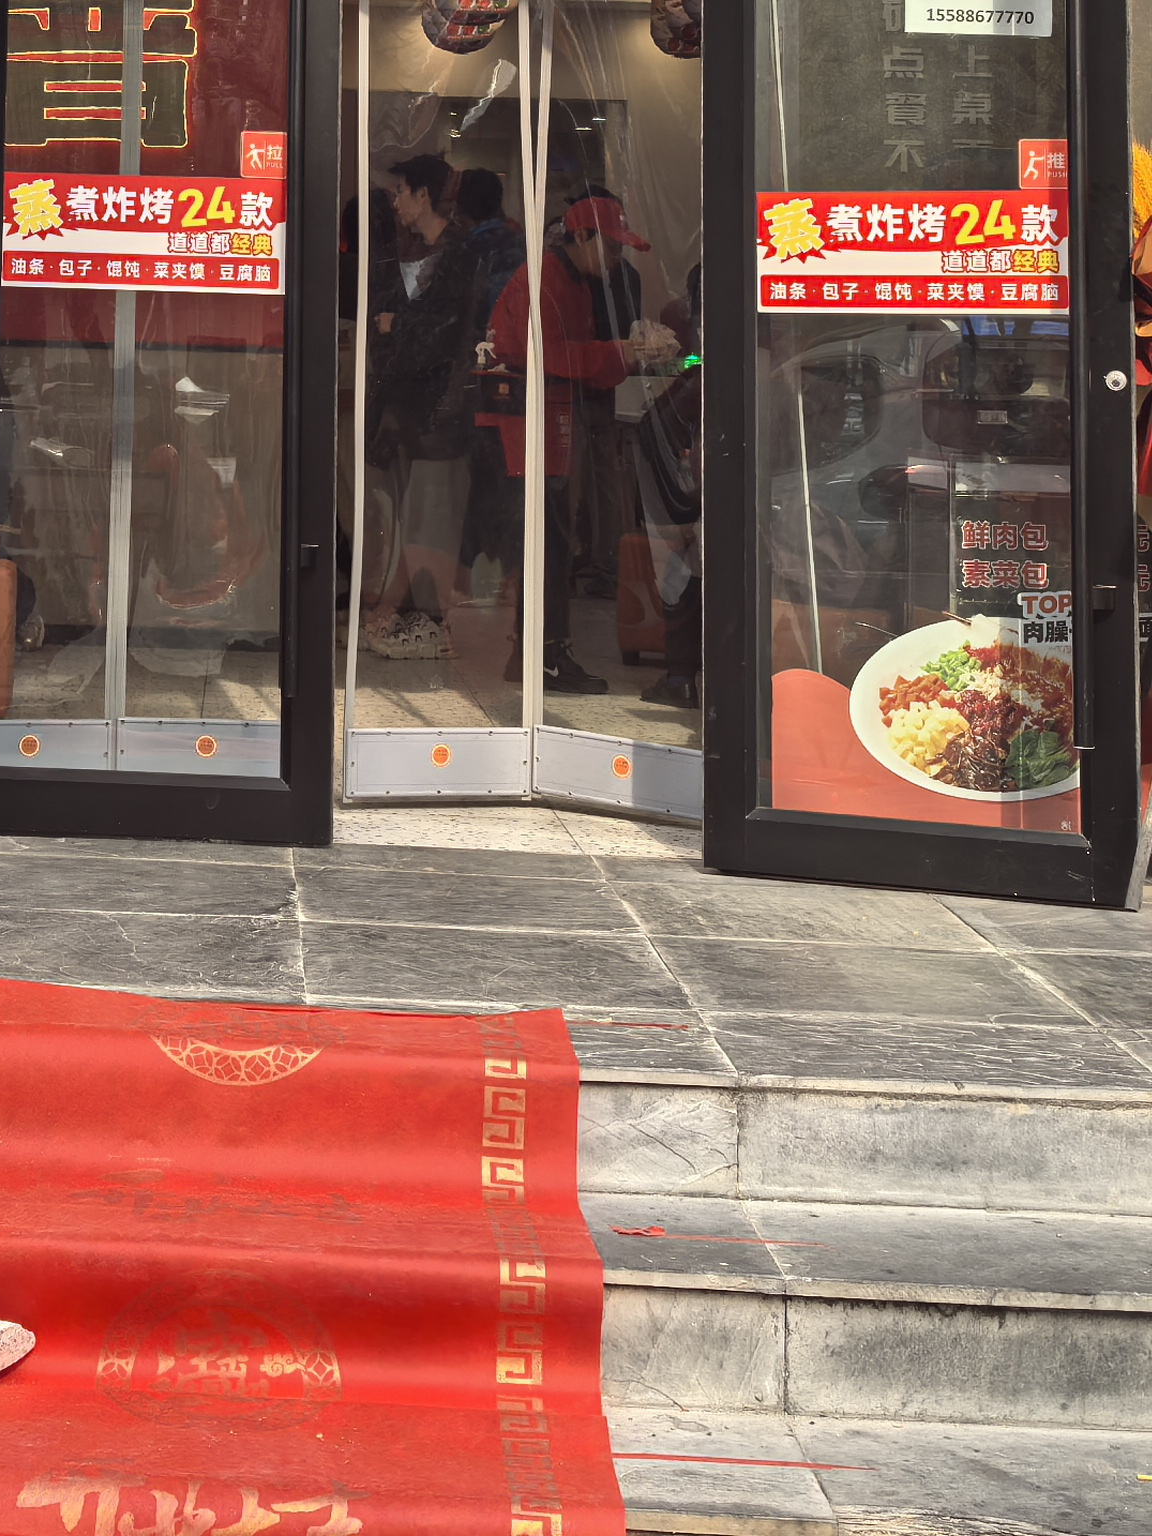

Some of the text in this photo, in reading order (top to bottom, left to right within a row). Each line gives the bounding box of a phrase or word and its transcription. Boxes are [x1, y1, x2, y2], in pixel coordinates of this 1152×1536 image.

[926, 8, 1034, 25] 15588677770
[266, 144, 283, 161] 拉
[1047, 152, 1066, 169] 推
[9, 178, 274, 236] 蒸煮炸烤24款
[763, 197, 1059, 259] 蒸煮炸烤24款
[167, 231, 273, 256] 道道都经典
[941, 249, 1060, 275] 道道都经典
[961, 519, 1049, 552] 鲜肉包
[961, 558, 1049, 590] 素菜包
[1022, 620, 1073, 644] 肉臊
